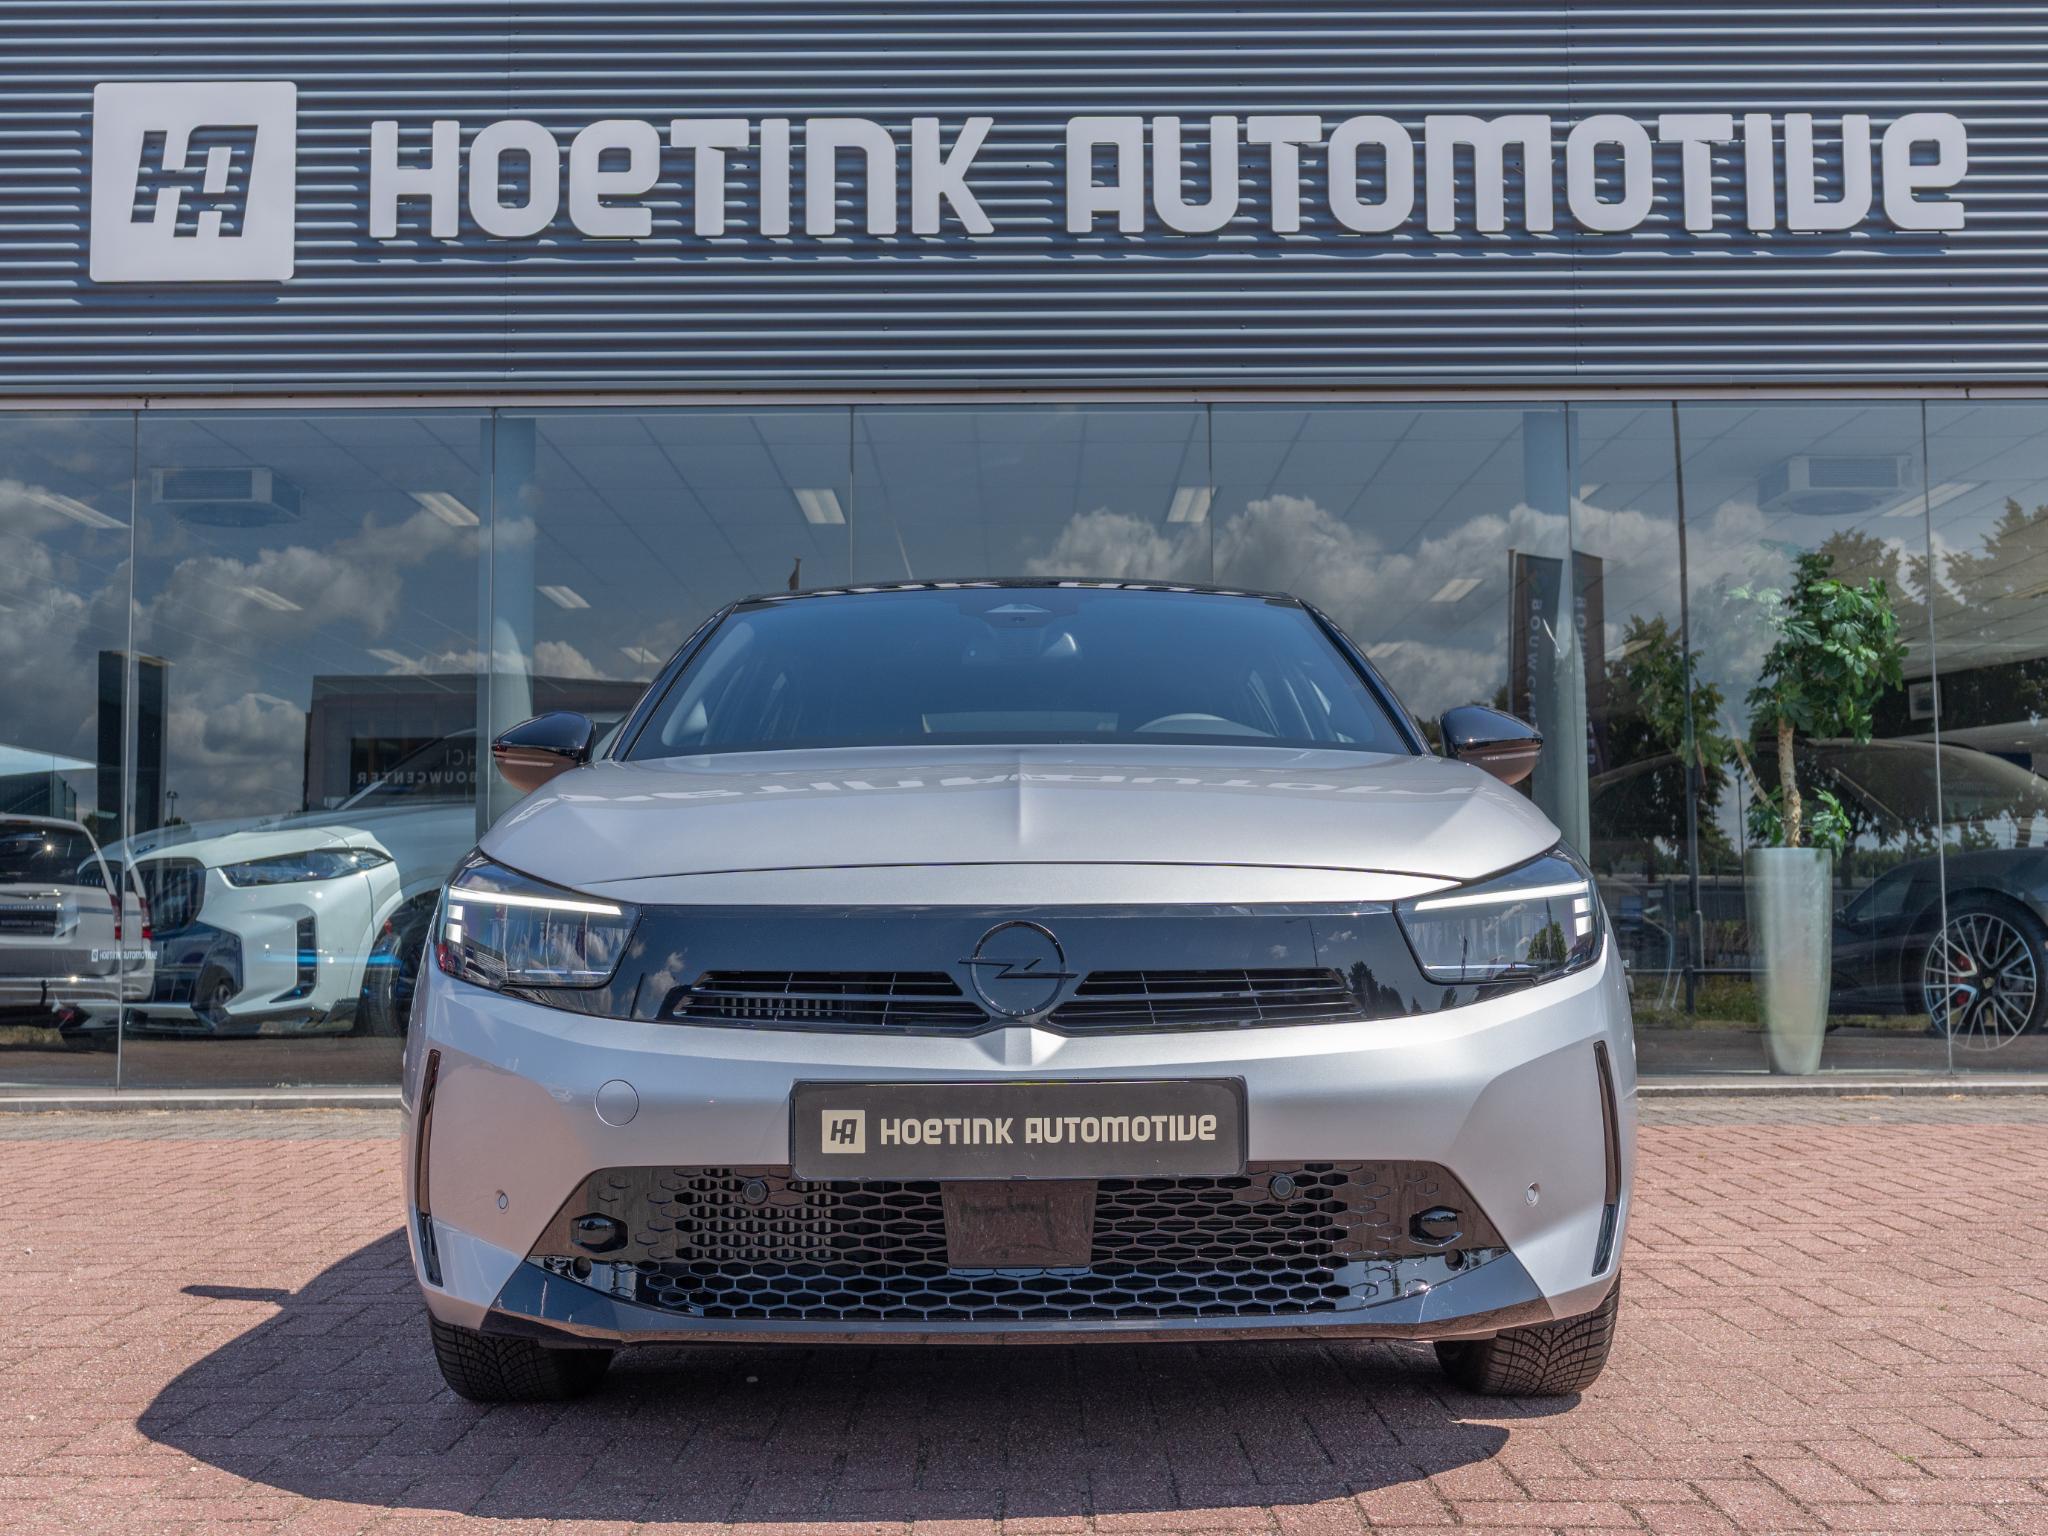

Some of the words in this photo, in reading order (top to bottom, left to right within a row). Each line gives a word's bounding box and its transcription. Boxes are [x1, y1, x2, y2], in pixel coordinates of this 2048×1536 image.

[368, 116, 995, 239] HOETINK
[1065, 112, 1970, 234] AUTOMOTIVE
[880, 1117, 1014, 1145] HOETINK
[1025, 1114, 1217, 1144] AUTOMOTIVE
